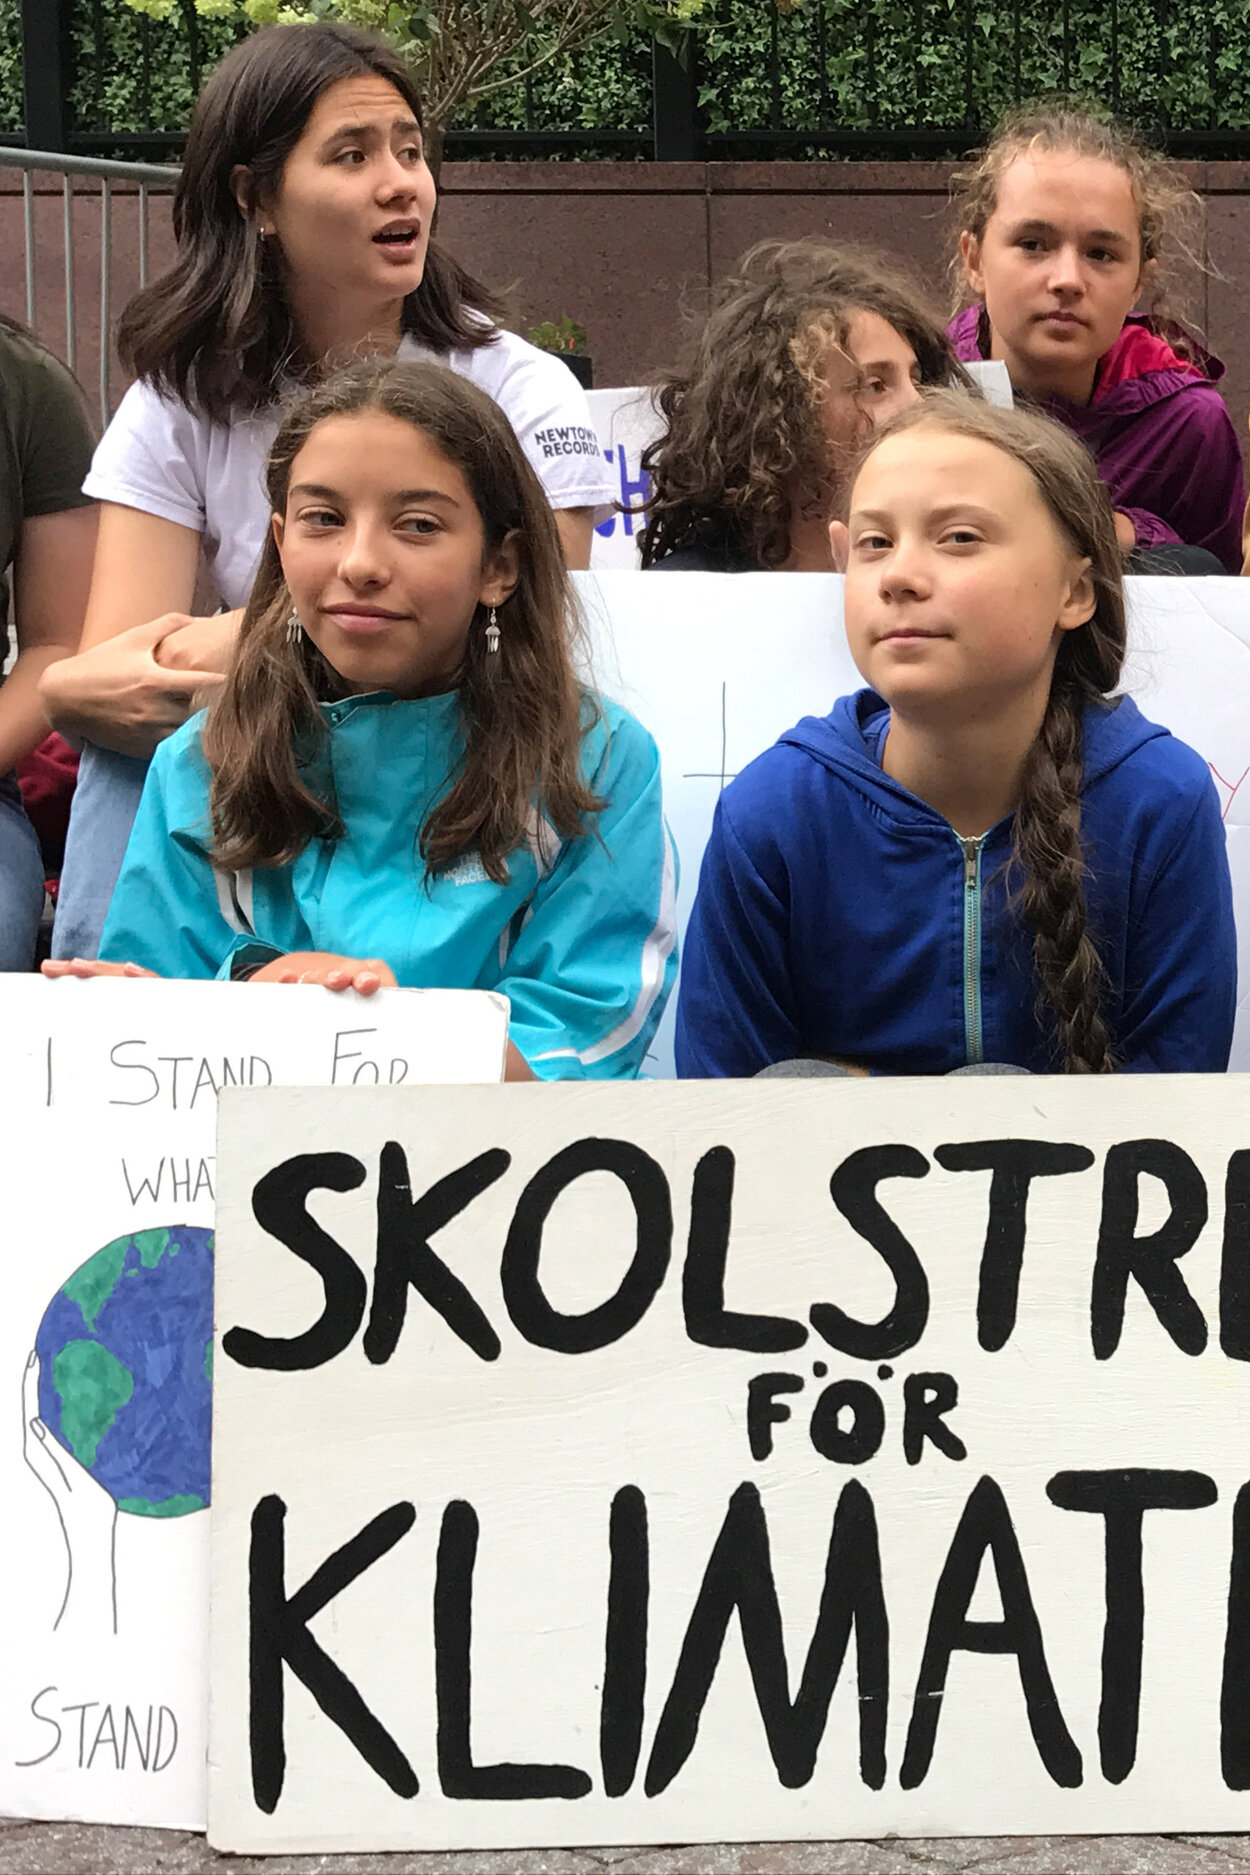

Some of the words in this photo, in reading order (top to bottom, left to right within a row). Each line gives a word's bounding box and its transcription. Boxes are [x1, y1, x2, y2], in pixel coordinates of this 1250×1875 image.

[543, 439, 601, 459] RECORDS
[121, 1156, 217, 1206] WHA
[746, 1359, 968, 1467] FÖR
[14, 1685, 179, 1774] STAND
